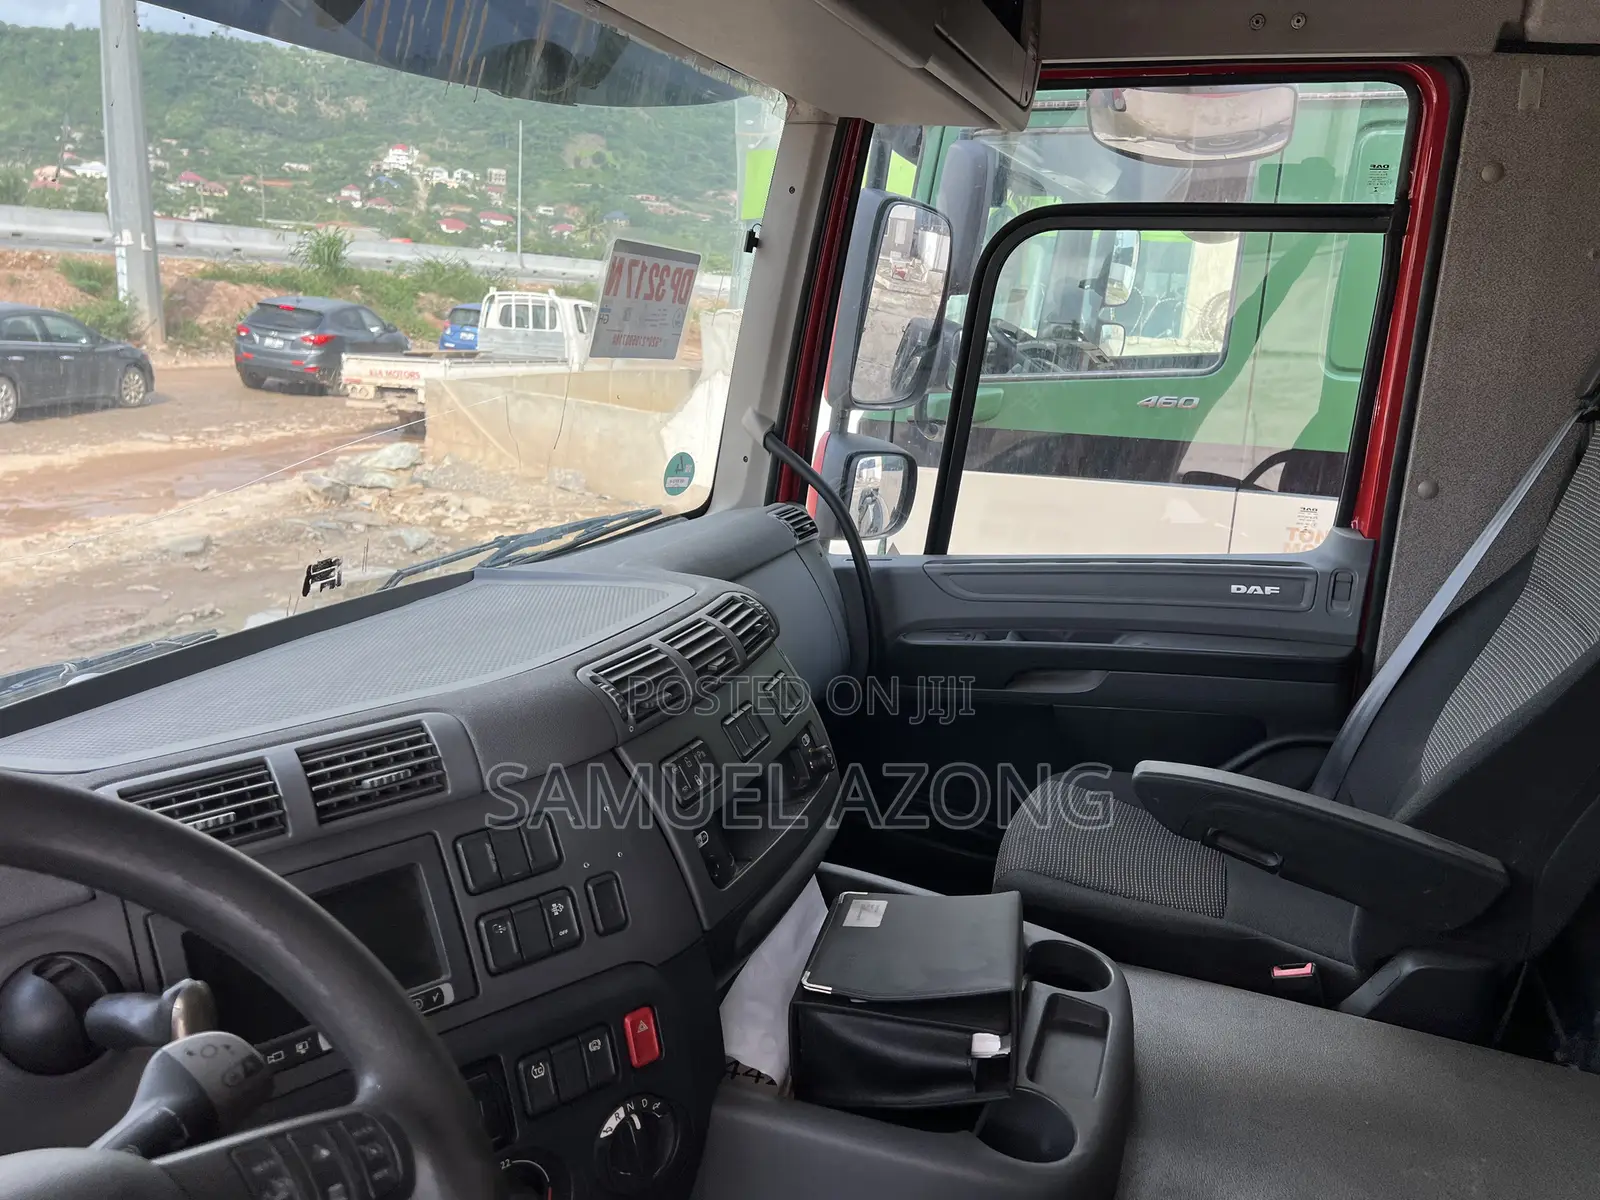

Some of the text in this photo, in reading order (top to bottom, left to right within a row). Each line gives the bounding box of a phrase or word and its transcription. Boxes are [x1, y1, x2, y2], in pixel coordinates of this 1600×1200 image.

[385, 370, 420, 380] MOTORS
[1136, 395, 1200, 409] 460
[1230, 584, 1280, 595] DAF
[626, 1100, 634, 1112] N
[641, 1098, 648, 1108] D
[614, 1112, 621, 1121] R
[500, 1158, 511, 1170] 22
